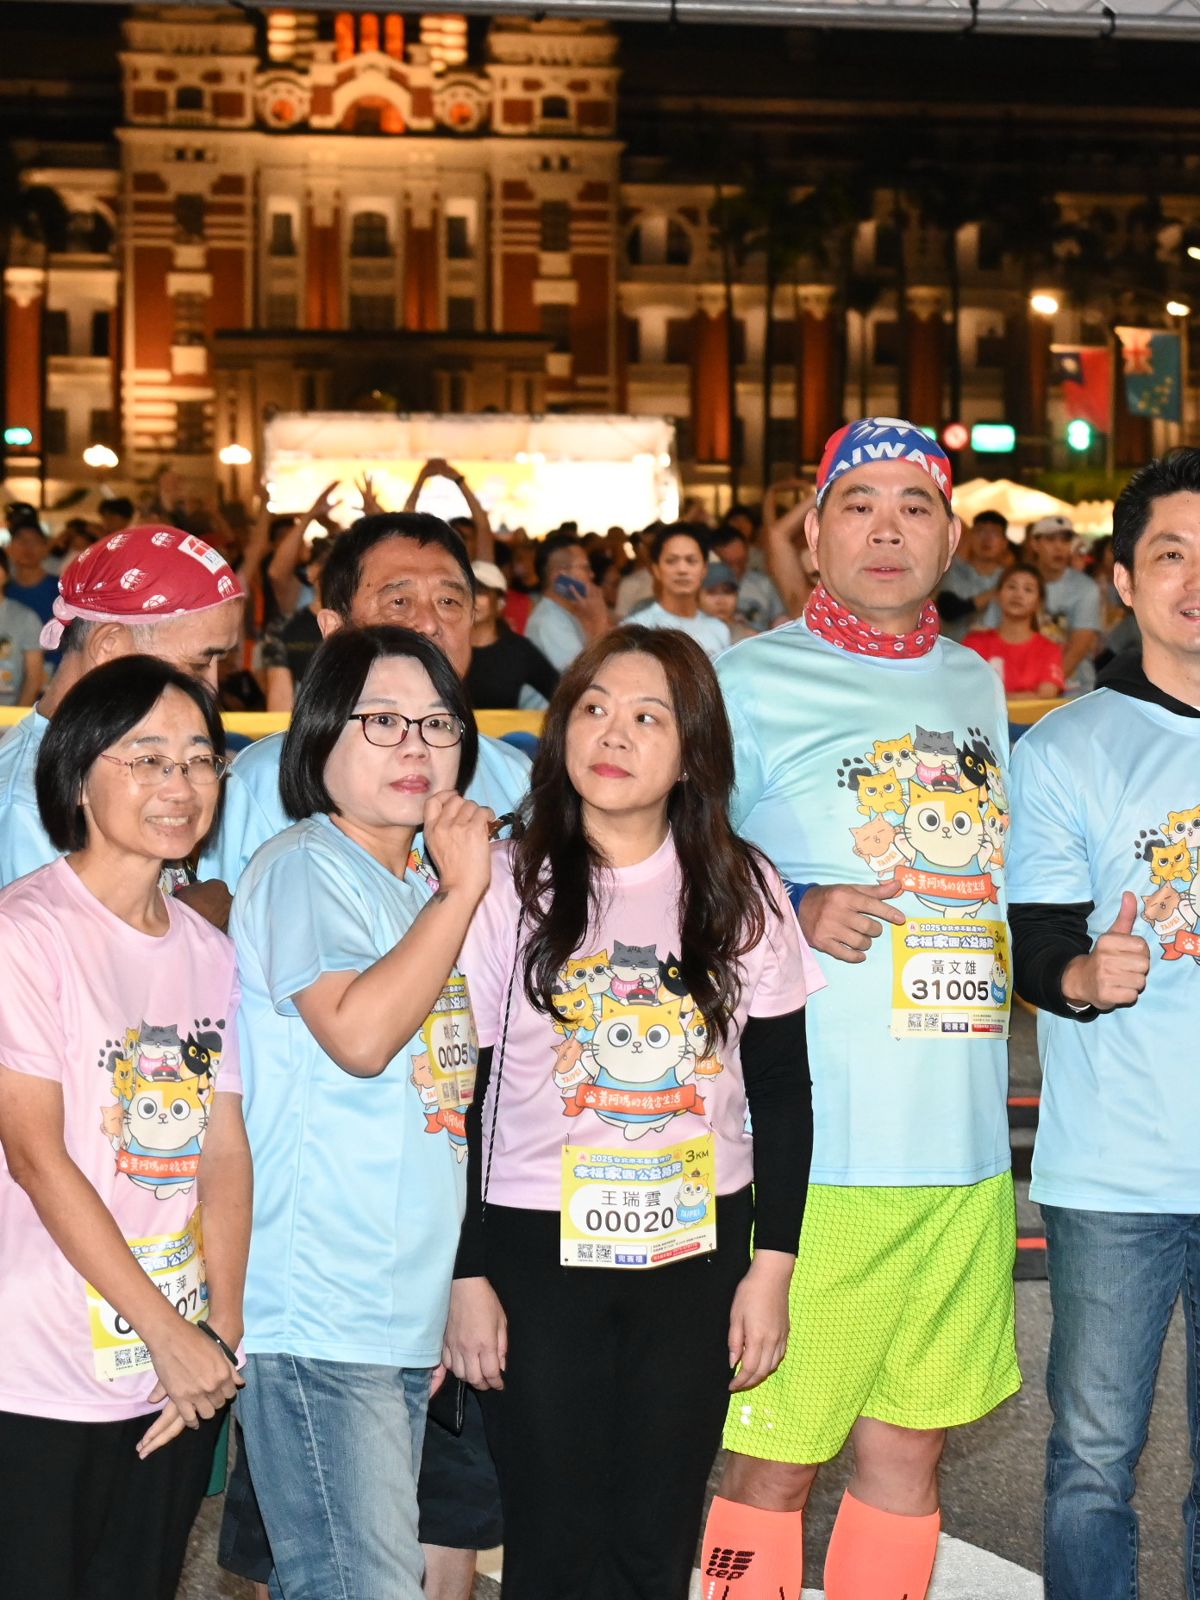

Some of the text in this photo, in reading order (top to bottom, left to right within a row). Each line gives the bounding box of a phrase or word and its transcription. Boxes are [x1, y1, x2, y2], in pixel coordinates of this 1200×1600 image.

[931, 960, 977, 975] 黃文雄
[911, 979, 989, 1001] 31005
[685, 1149, 709, 1163] 3KM
[601, 1190, 661, 1207] 王瑞雲
[586, 1207, 674, 1233] 00020
[705, 1567, 745, 1581] cep
